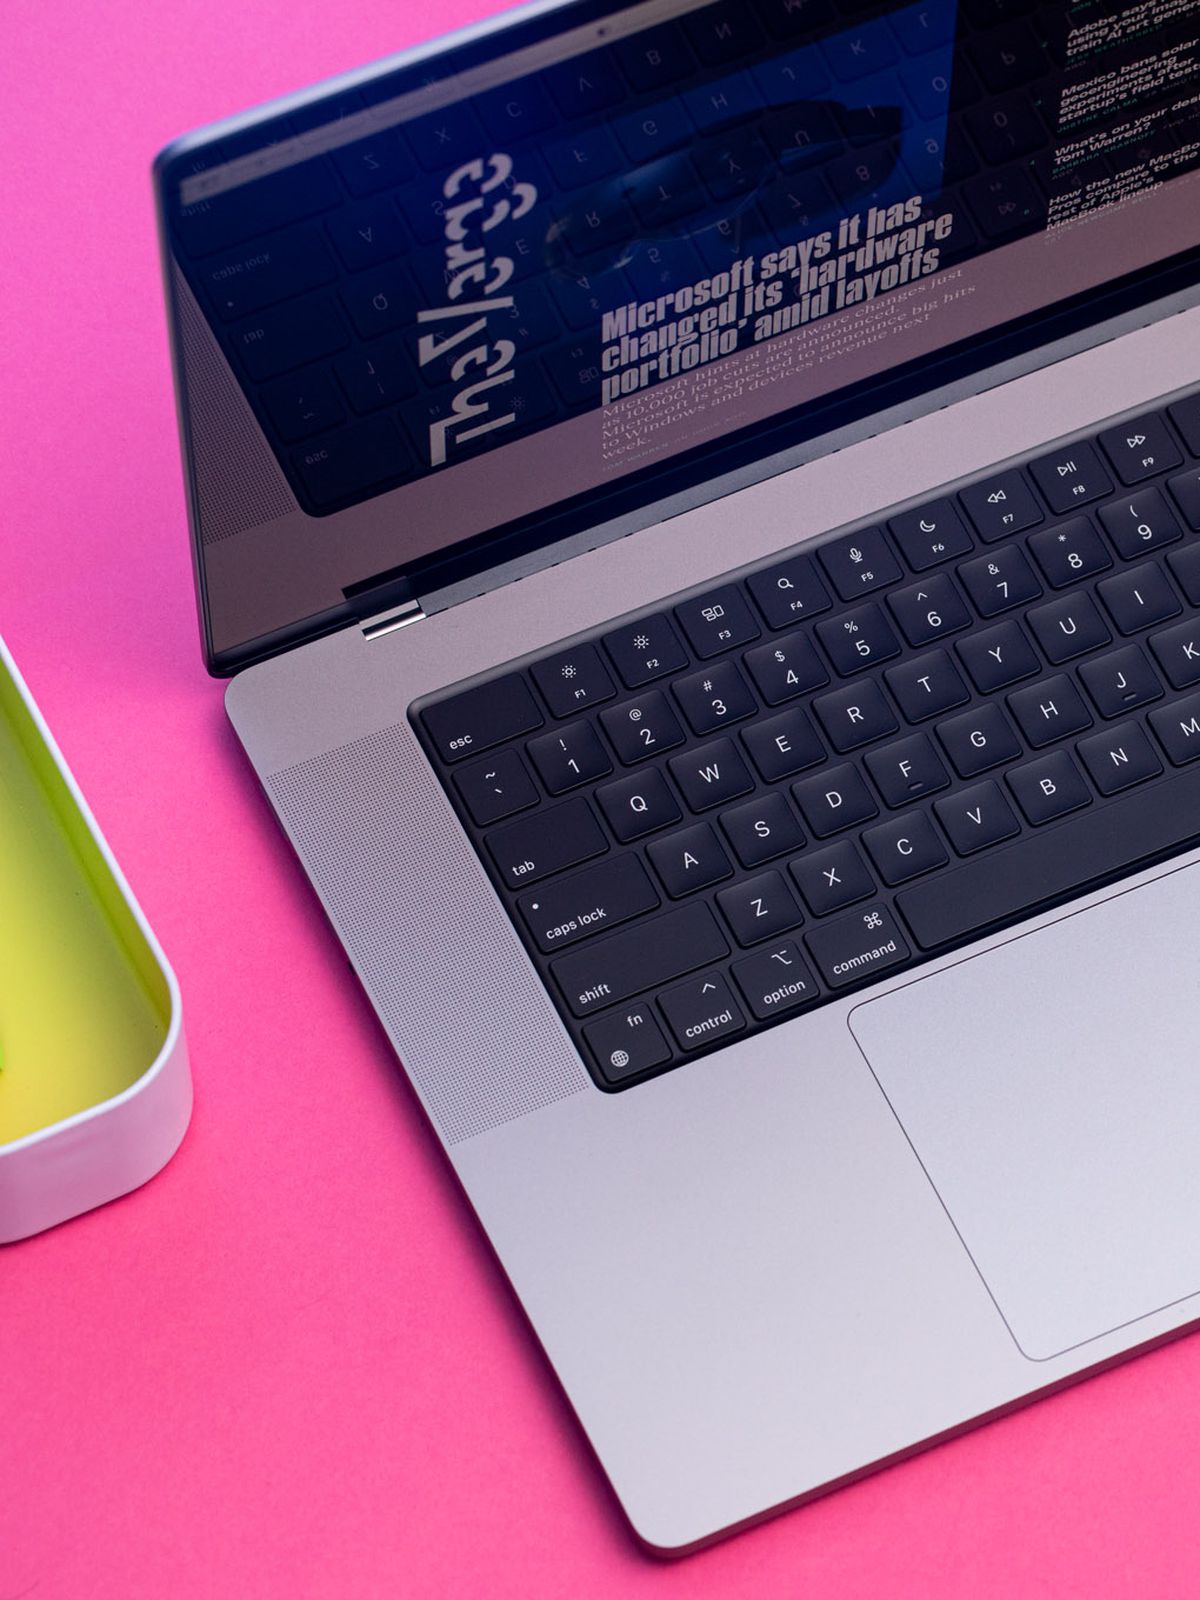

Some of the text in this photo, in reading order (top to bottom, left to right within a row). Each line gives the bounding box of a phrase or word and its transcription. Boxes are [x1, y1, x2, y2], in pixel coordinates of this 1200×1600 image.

[1068, 15, 1118, 39] Adobe
[1122, 0, 1157, 18] says
[1066, 38, 1103, 57] train
[1126, 19, 1150, 34] art
[1067, 26, 1109, 48] using
[1113, 11, 1148, 32] your
[1061, 38, 1200, 98] Mexico bans solar
[1059, 74, 1153, 115] experiments
[1157, 57, 1195, 77] after
[1060, 56, 1178, 108] geoengineering
[1059, 92, 1128, 124] startup's
[1131, 76, 1164, 95] field
[1055, 132, 1108, 157] What's
[1111, 123, 1130, 135] on
[1134, 108, 1168, 128] your
[1054, 121, 1151, 165] Tom Warren?
[1048, 197, 1082, 215] Pros
[1085, 170, 1150, 200] compare
[1153, 162, 1170, 173] to
[1173, 151, 1198, 165] the
[1049, 188, 1082, 207] How
[1085, 178, 1111, 192] the
[1114, 163, 1146, 181] new
[1045, 200, 1116, 231] MacBook
[1118, 181, 1164, 203] lineup
[1047, 206, 1077, 223] rest
[1080, 197, 1097, 210] of
[1100, 176, 1154, 202] Apple's
[602, 195, 923, 344] Microsoft says it has
[754, 285, 830, 342] amid
[835, 247, 941, 315] layoffs
[602, 292, 737, 372] changed
[744, 280, 783, 317] its
[603, 269, 962, 417] Microsoft hints at hardware changes just
[601, 419, 621, 430] as
[691, 378, 718, 396] job
[722, 363, 760, 381] cuts
[765, 348, 793, 365] are
[797, 305, 899, 352] announced.
[603, 287, 976, 440] Microsoft is expected to announce big hits
[602, 438, 620, 450] to
[625, 405, 706, 440] Windows
[711, 386, 743, 406] and
[748, 362, 814, 391] devices
[819, 331, 888, 364] revenue
[893, 313, 929, 334] next
[602, 437, 652, 460] week.
[1141, 456, 1155, 468] F9
[1072, 484, 1086, 496] F8
[1002, 513, 1014, 525] F7
[1137, 523, 1153, 541] 9
[931, 542, 945, 554] F6
[988, 563, 1000, 575] &
[1067, 552, 1084, 569] 8
[860, 570, 874, 582] F5
[996, 581, 1008, 599] 7
[1133, 589, 1145, 605] I
[789, 600, 804, 611] F4
[843, 620, 859, 634] %
[926, 610, 942, 628] 6
[1058, 616, 1077, 635] U
[718, 629, 732, 641] F3
[774, 650, 786, 663] $
[855, 639, 871, 657] 5
[987, 646, 1003, 664] Y
[1182, 641, 1200, 660] K
[646, 658, 660, 670] F2
[702, 679, 713, 693] #
[786, 669, 800, 685] 4
[916, 675, 932, 693] T
[1116, 671, 1127, 689] J
[574, 688, 587, 699] F1
[628, 708, 642, 722] @
[711, 698, 727, 716] 3
[846, 706, 865, 724] R
[1039, 700, 1059, 720] H
[1179, 717, 1200, 737] M
[448, 734, 473, 750] esc
[558, 738, 568, 752] !
[639, 728, 657, 746] 2
[774, 734, 792, 753] E
[969, 730, 987, 748] G
[567, 758, 581, 774] 1
[1109, 747, 1129, 767] N
[698, 763, 720, 784] W
[898, 759, 912, 778] F
[1039, 778, 1057, 796] B
[629, 795, 649, 813] Q
[825, 790, 843, 809] D
[966, 806, 982, 825] V
[754, 820, 771, 838] S
[896, 838, 913, 856] C
[511, 860, 536, 877] tab
[683, 851, 700, 870] A
[822, 867, 842, 887] X
[749, 897, 769, 918] Z
[545, 906, 607, 941] caps lock
[832, 939, 898, 976] command
[578, 983, 612, 1005] shift
[763, 980, 806, 1006] option
[626, 1014, 644, 1028] fn
[685, 1009, 733, 1038] control
